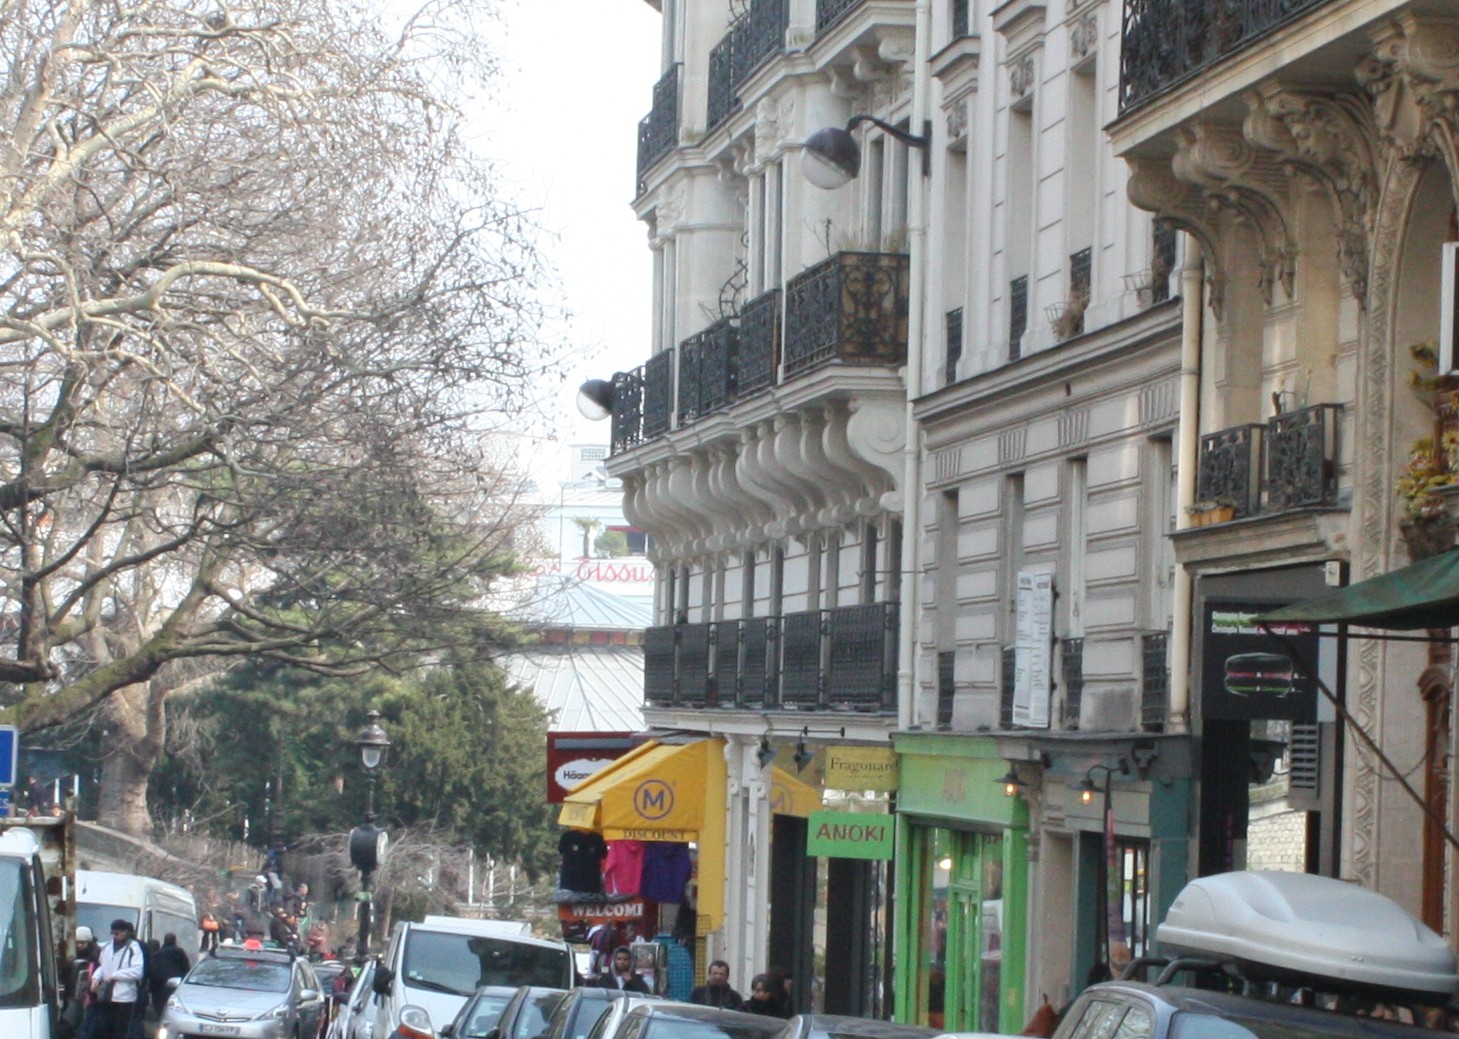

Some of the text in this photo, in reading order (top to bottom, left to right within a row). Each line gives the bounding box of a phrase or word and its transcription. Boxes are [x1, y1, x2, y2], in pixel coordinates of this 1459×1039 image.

[643, 789, 664, 811] M
[623, 829, 685, 841] DISCOUNT
[816, 822, 886, 842] ANOKI
